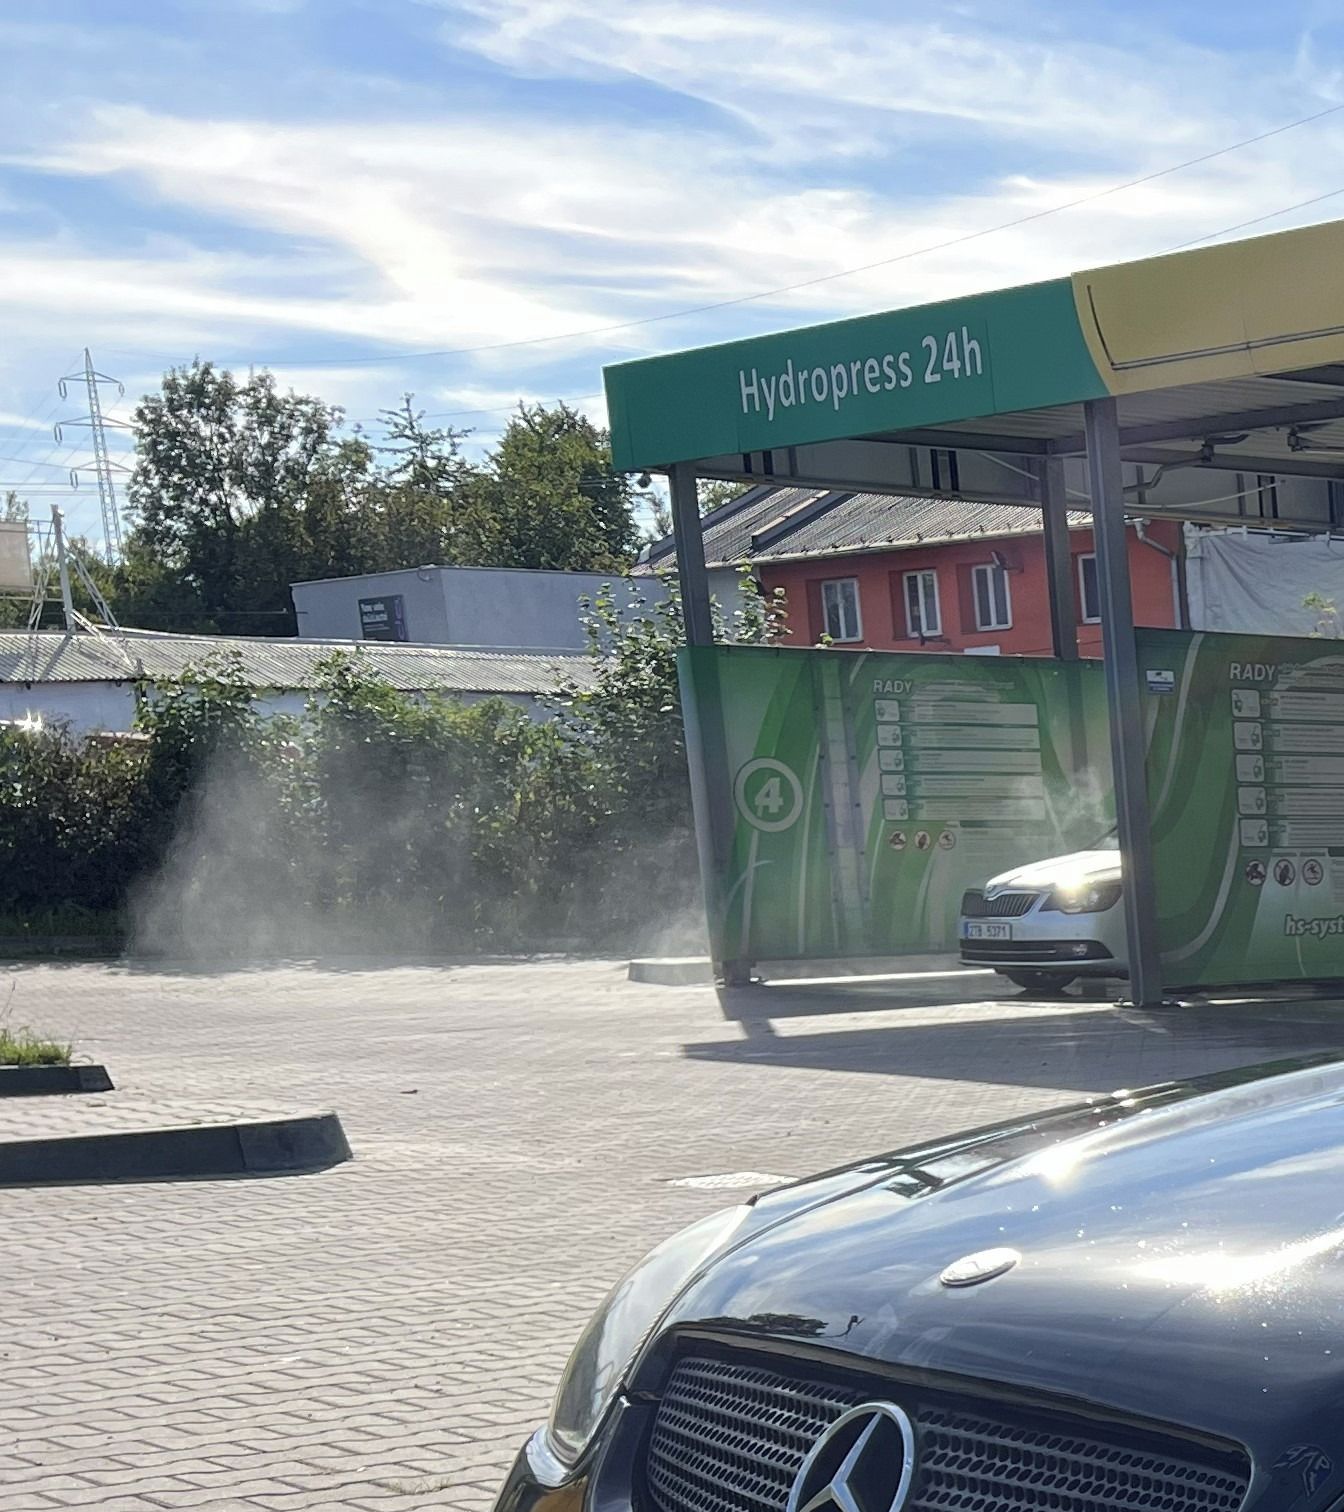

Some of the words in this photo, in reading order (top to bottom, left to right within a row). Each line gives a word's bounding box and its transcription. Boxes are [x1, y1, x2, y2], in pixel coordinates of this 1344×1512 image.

[739, 351, 913, 422] Hydropress
[921, 326, 983, 384] 24h
[872, 679, 912, 694] RADY
[1229, 662, 1277, 682] RADY
[754, 776, 785, 814] 4
